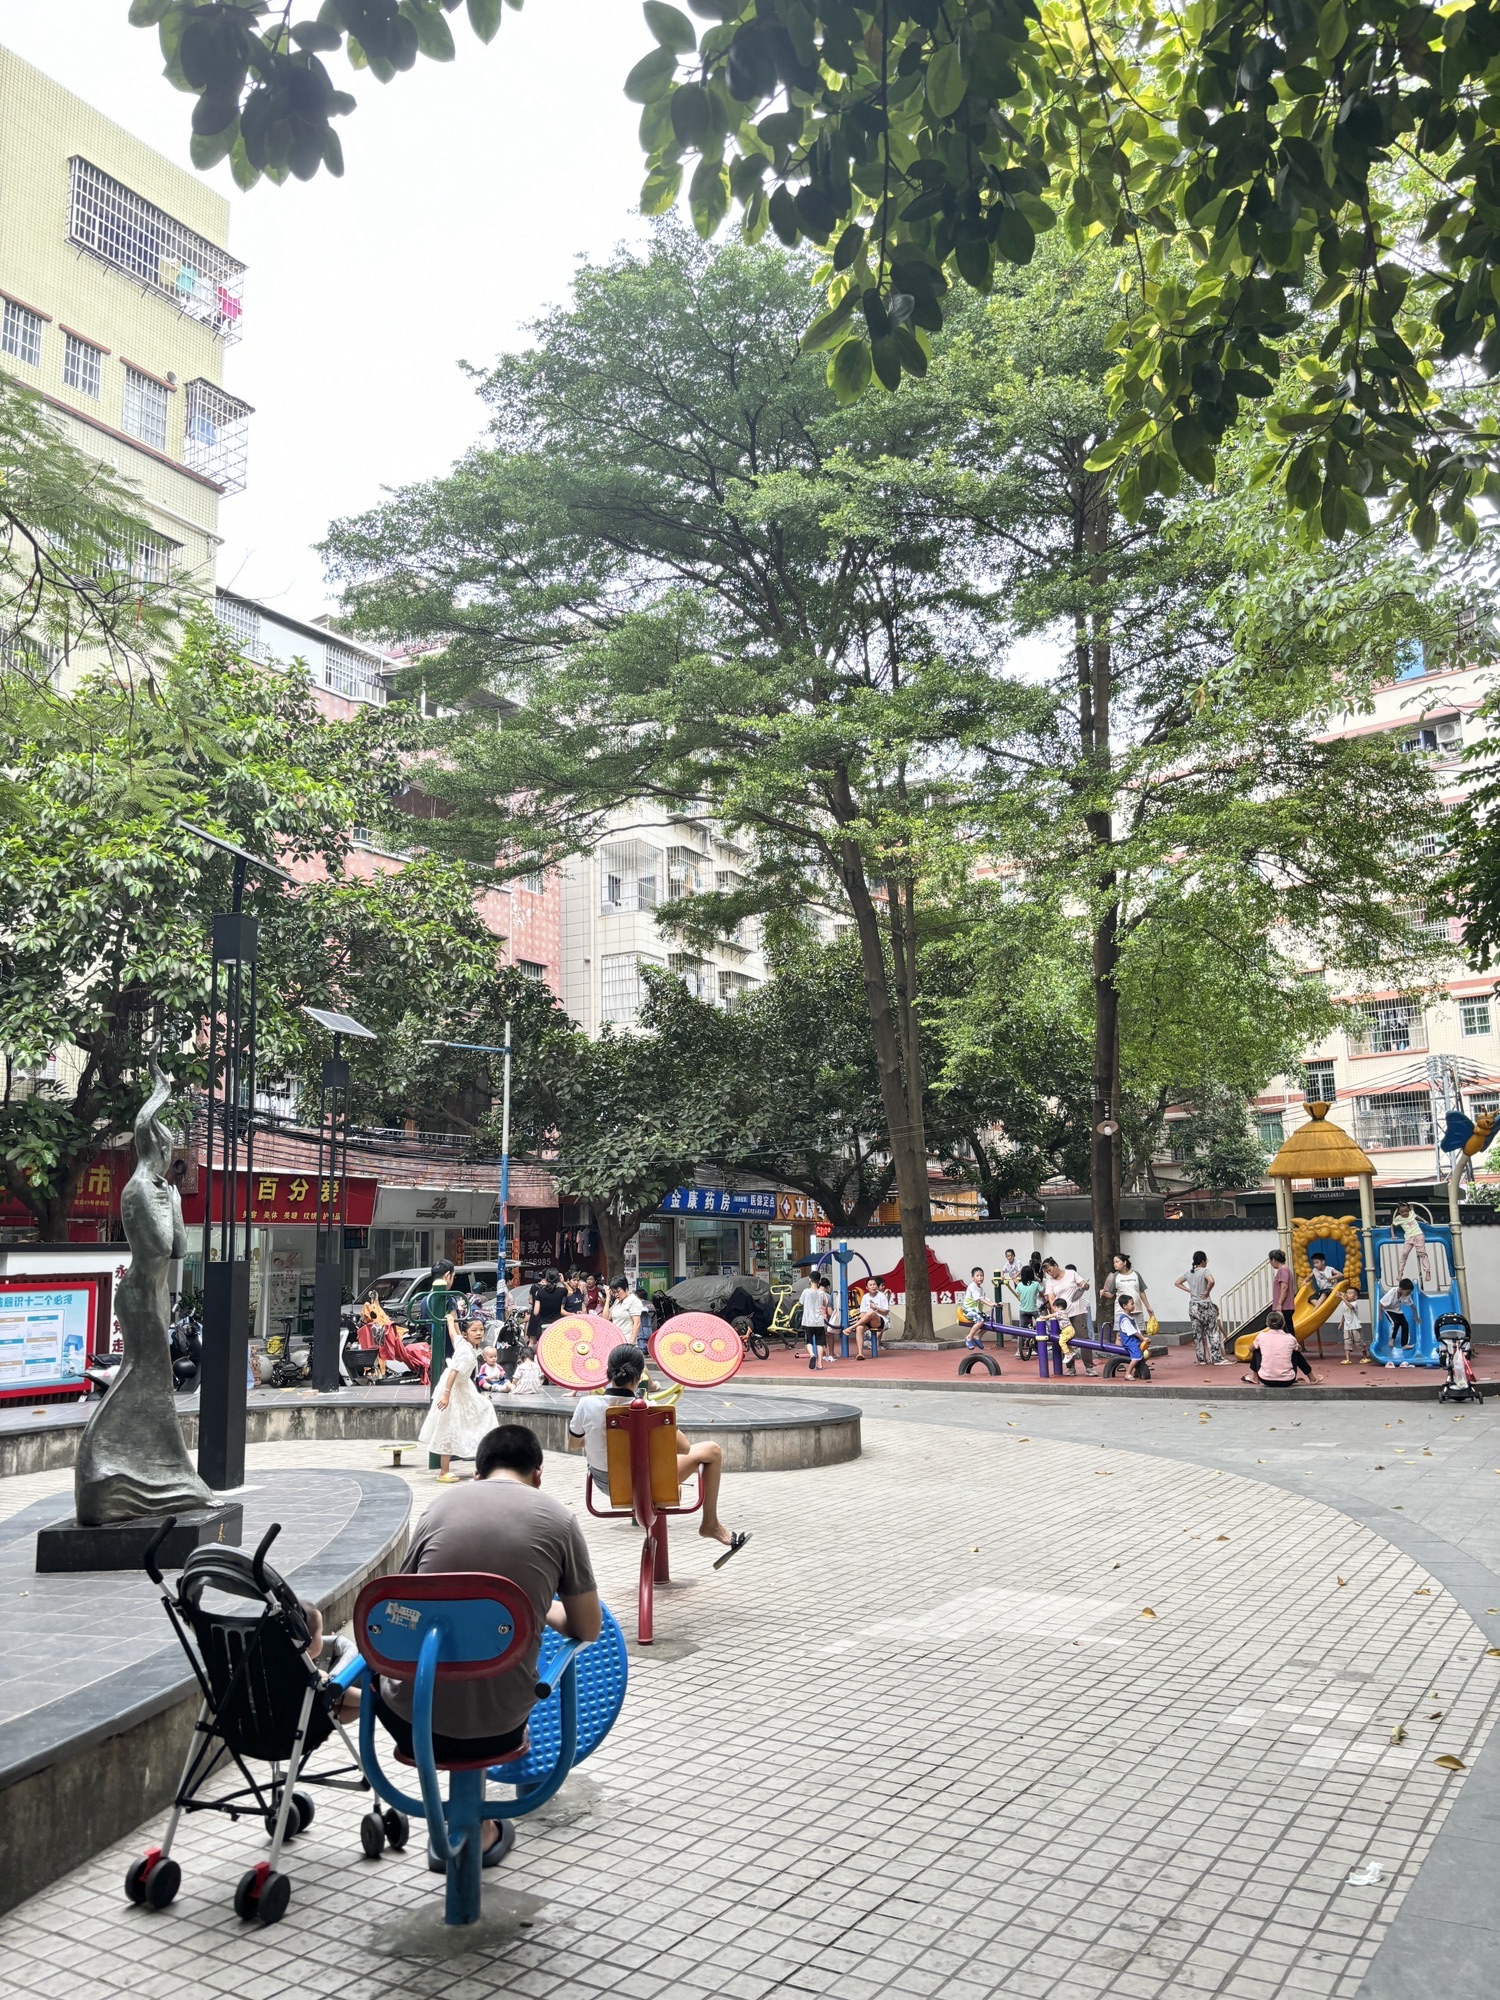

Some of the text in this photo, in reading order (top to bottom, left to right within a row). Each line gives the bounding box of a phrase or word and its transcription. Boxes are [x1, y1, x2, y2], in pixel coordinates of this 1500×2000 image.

[257, 1176, 340, 1203] 百分爱
[670, 1188, 731, 1212] 金康药房
[750, 1194, 775, 1208] 医保定点
